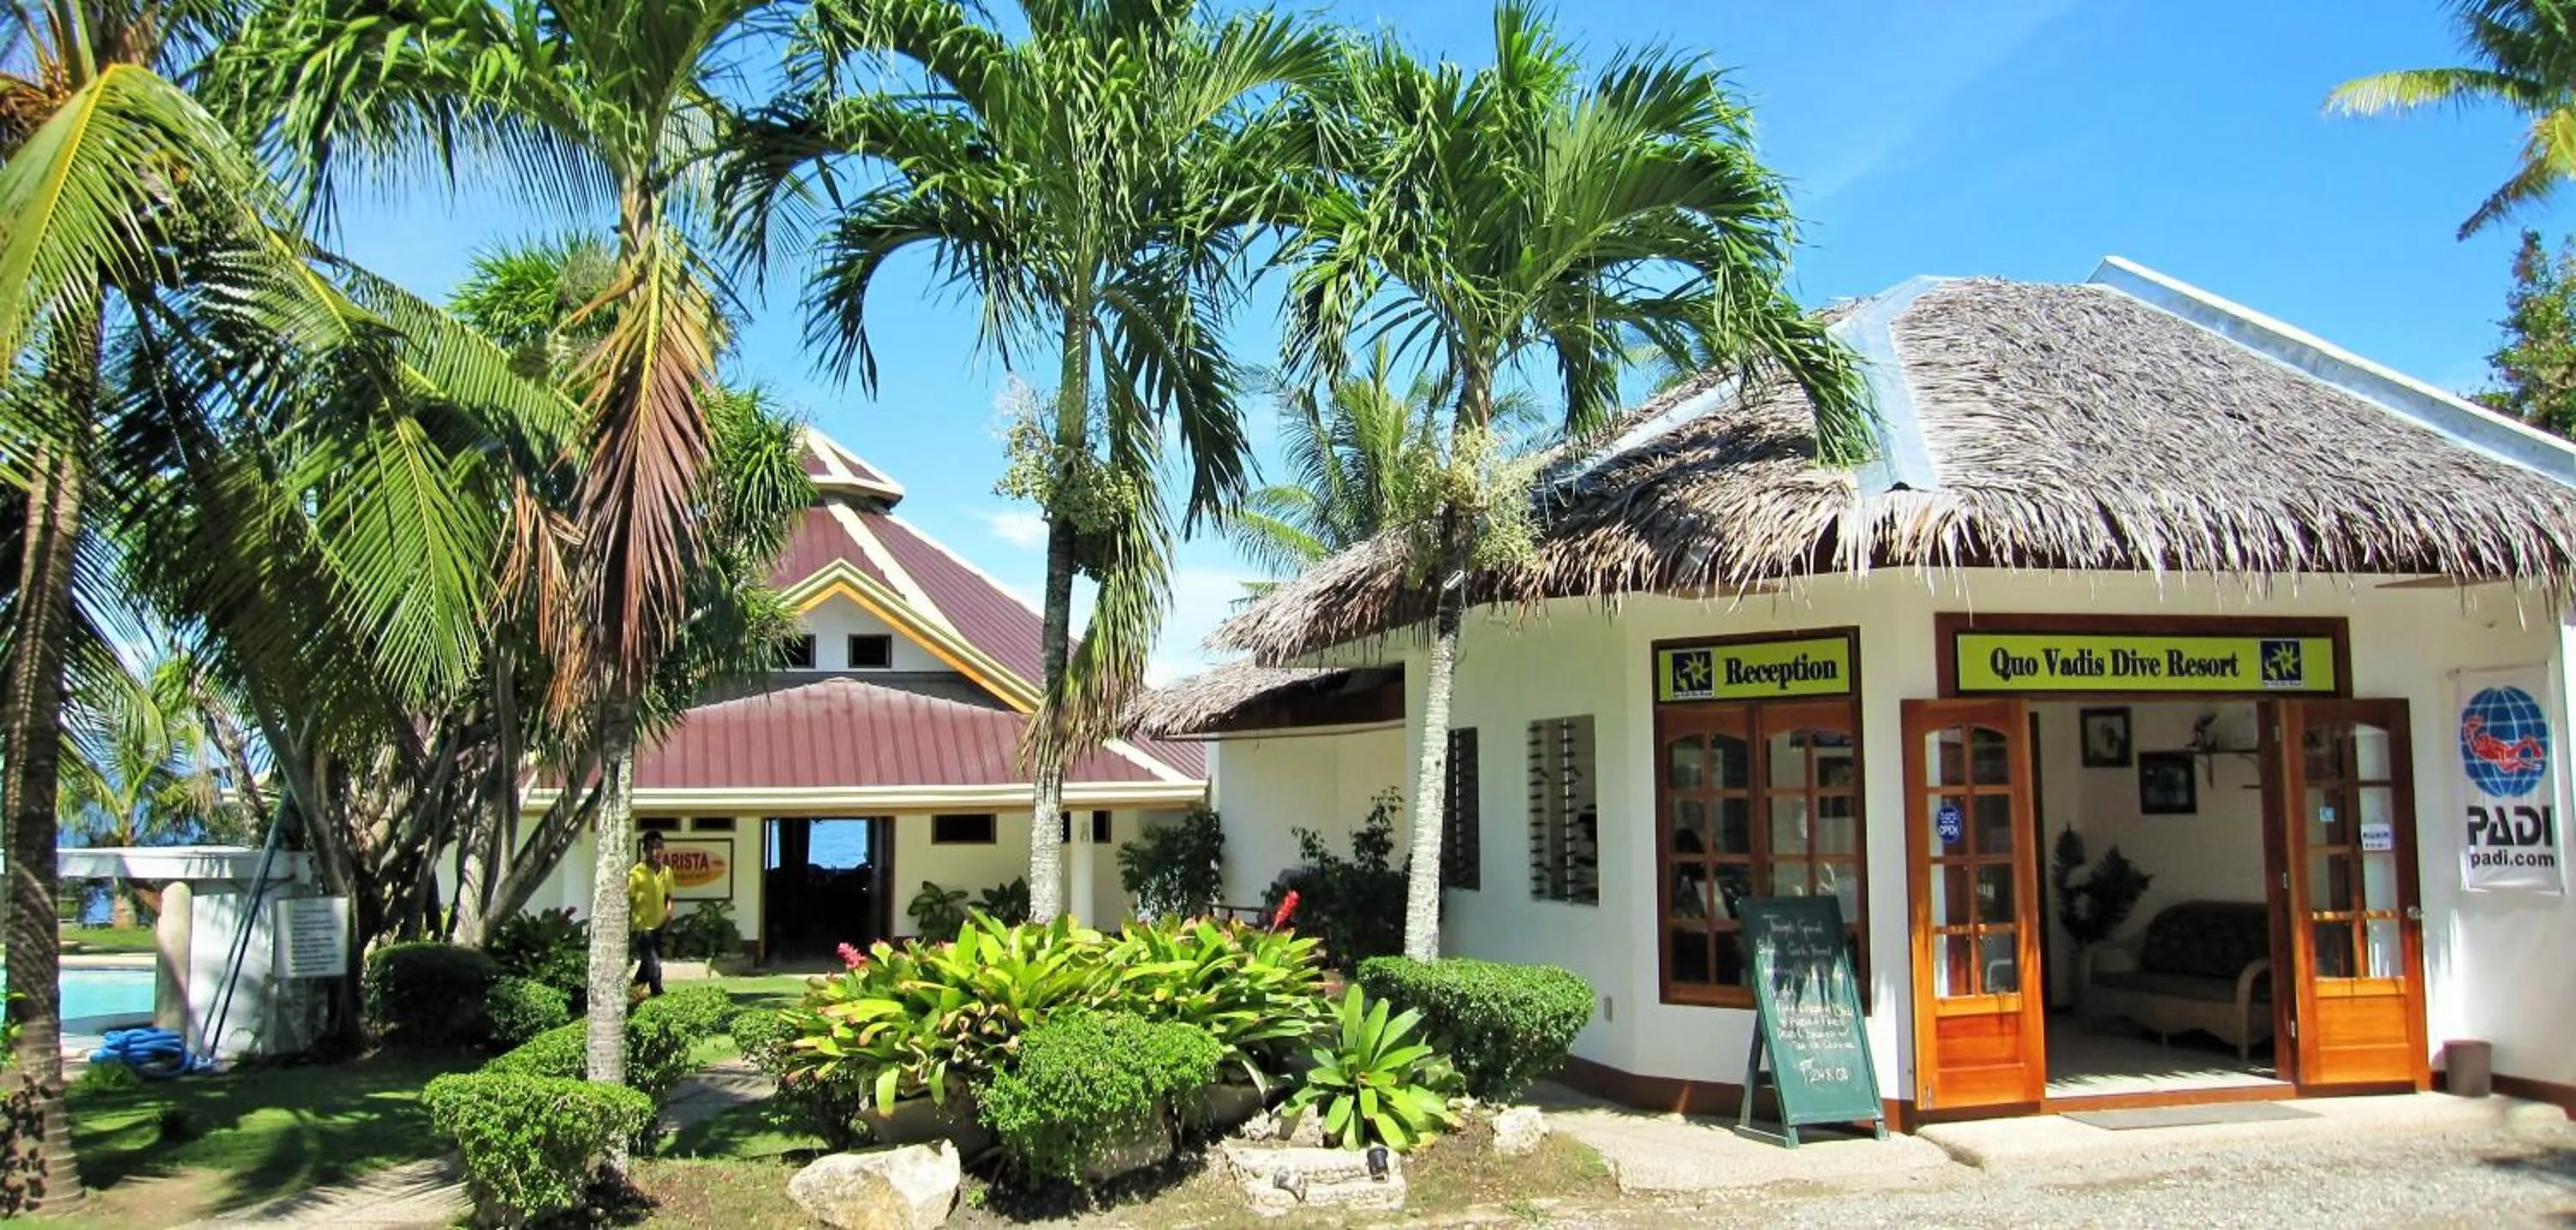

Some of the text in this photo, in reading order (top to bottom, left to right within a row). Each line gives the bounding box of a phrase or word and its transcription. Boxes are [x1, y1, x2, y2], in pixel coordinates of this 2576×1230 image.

[1724, 652, 1838, 690] Reception
[1990, 647, 2240, 683] Quo Vadis Dive Resort
[2467, 806, 2553, 847] PADI
[662, 851, 709, 870] ARISTA
[2470, 849, 2555, 869] padi.com
